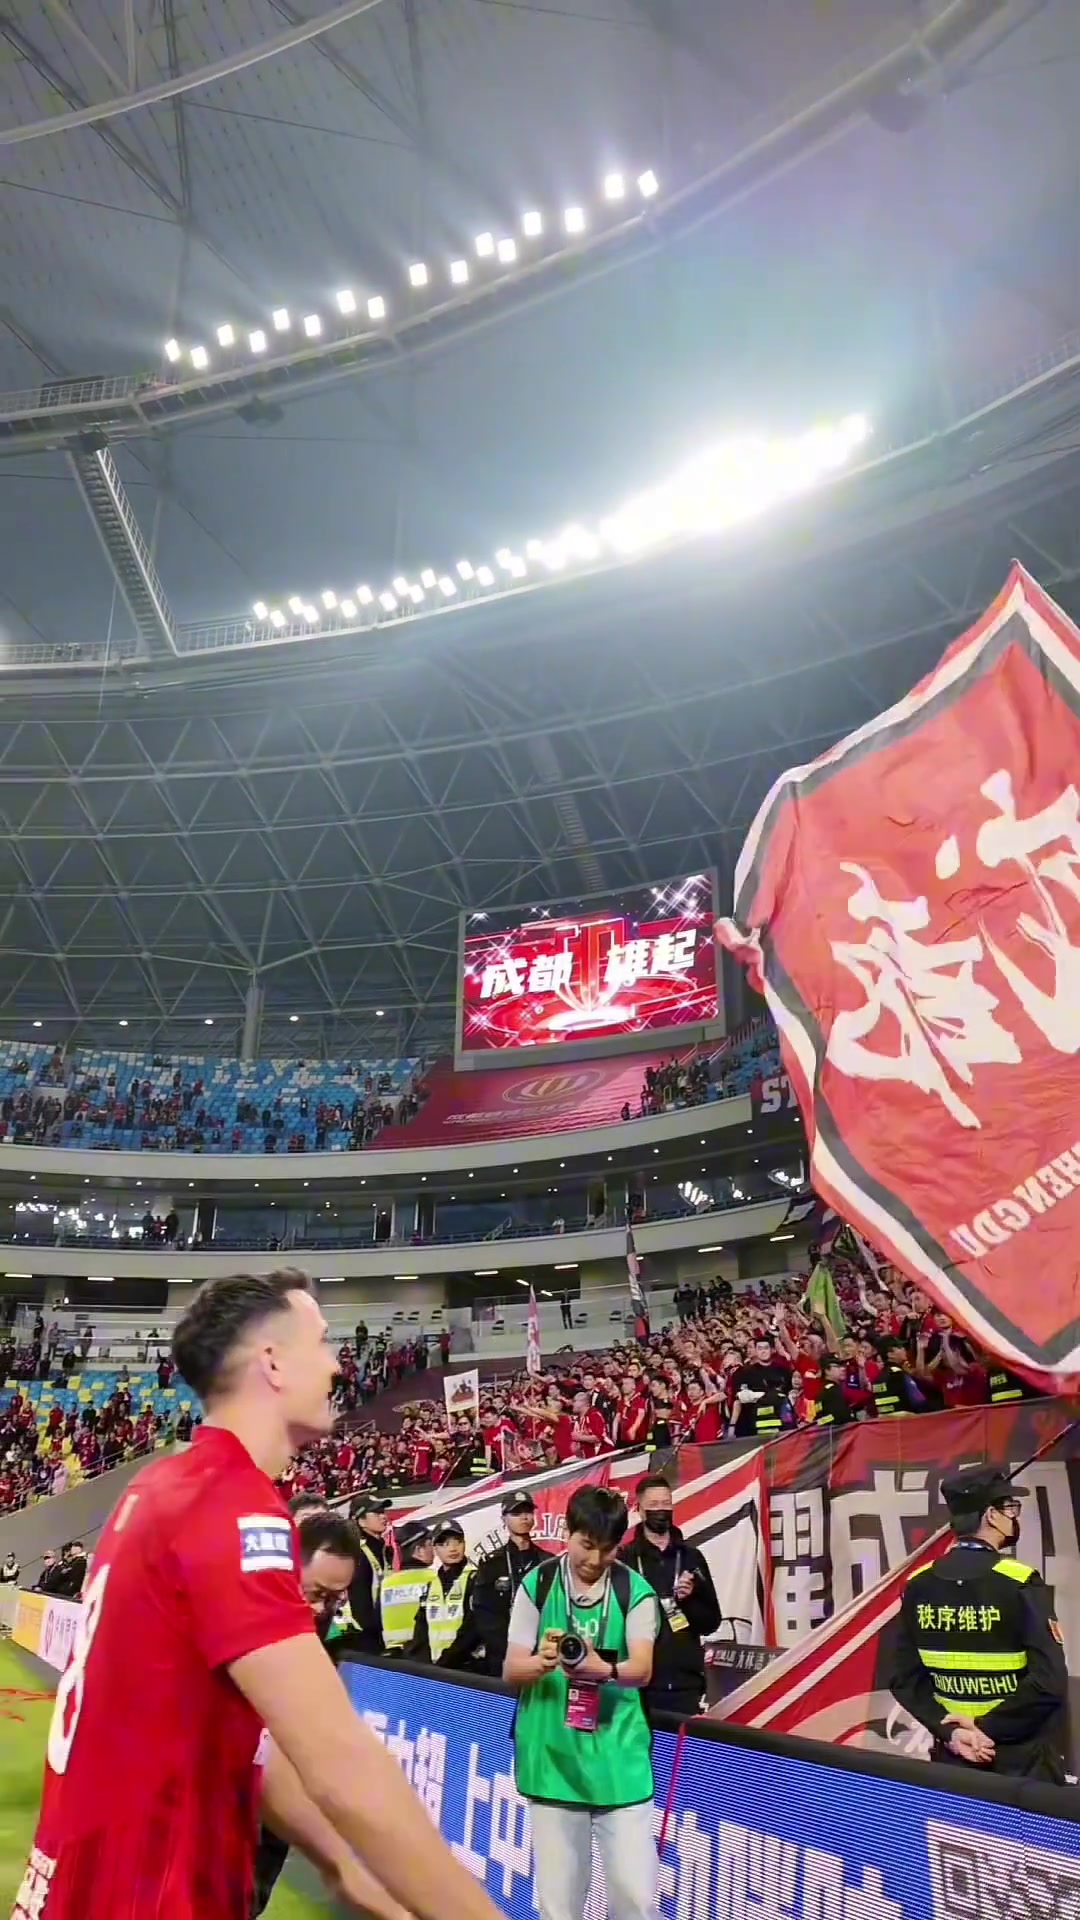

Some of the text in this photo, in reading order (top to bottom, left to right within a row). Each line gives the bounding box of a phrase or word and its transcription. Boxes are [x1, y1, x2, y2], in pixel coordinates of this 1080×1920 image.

[480, 929, 697, 998] 成都 雄起
[917, 1604, 1001, 1631] 秩序维护
